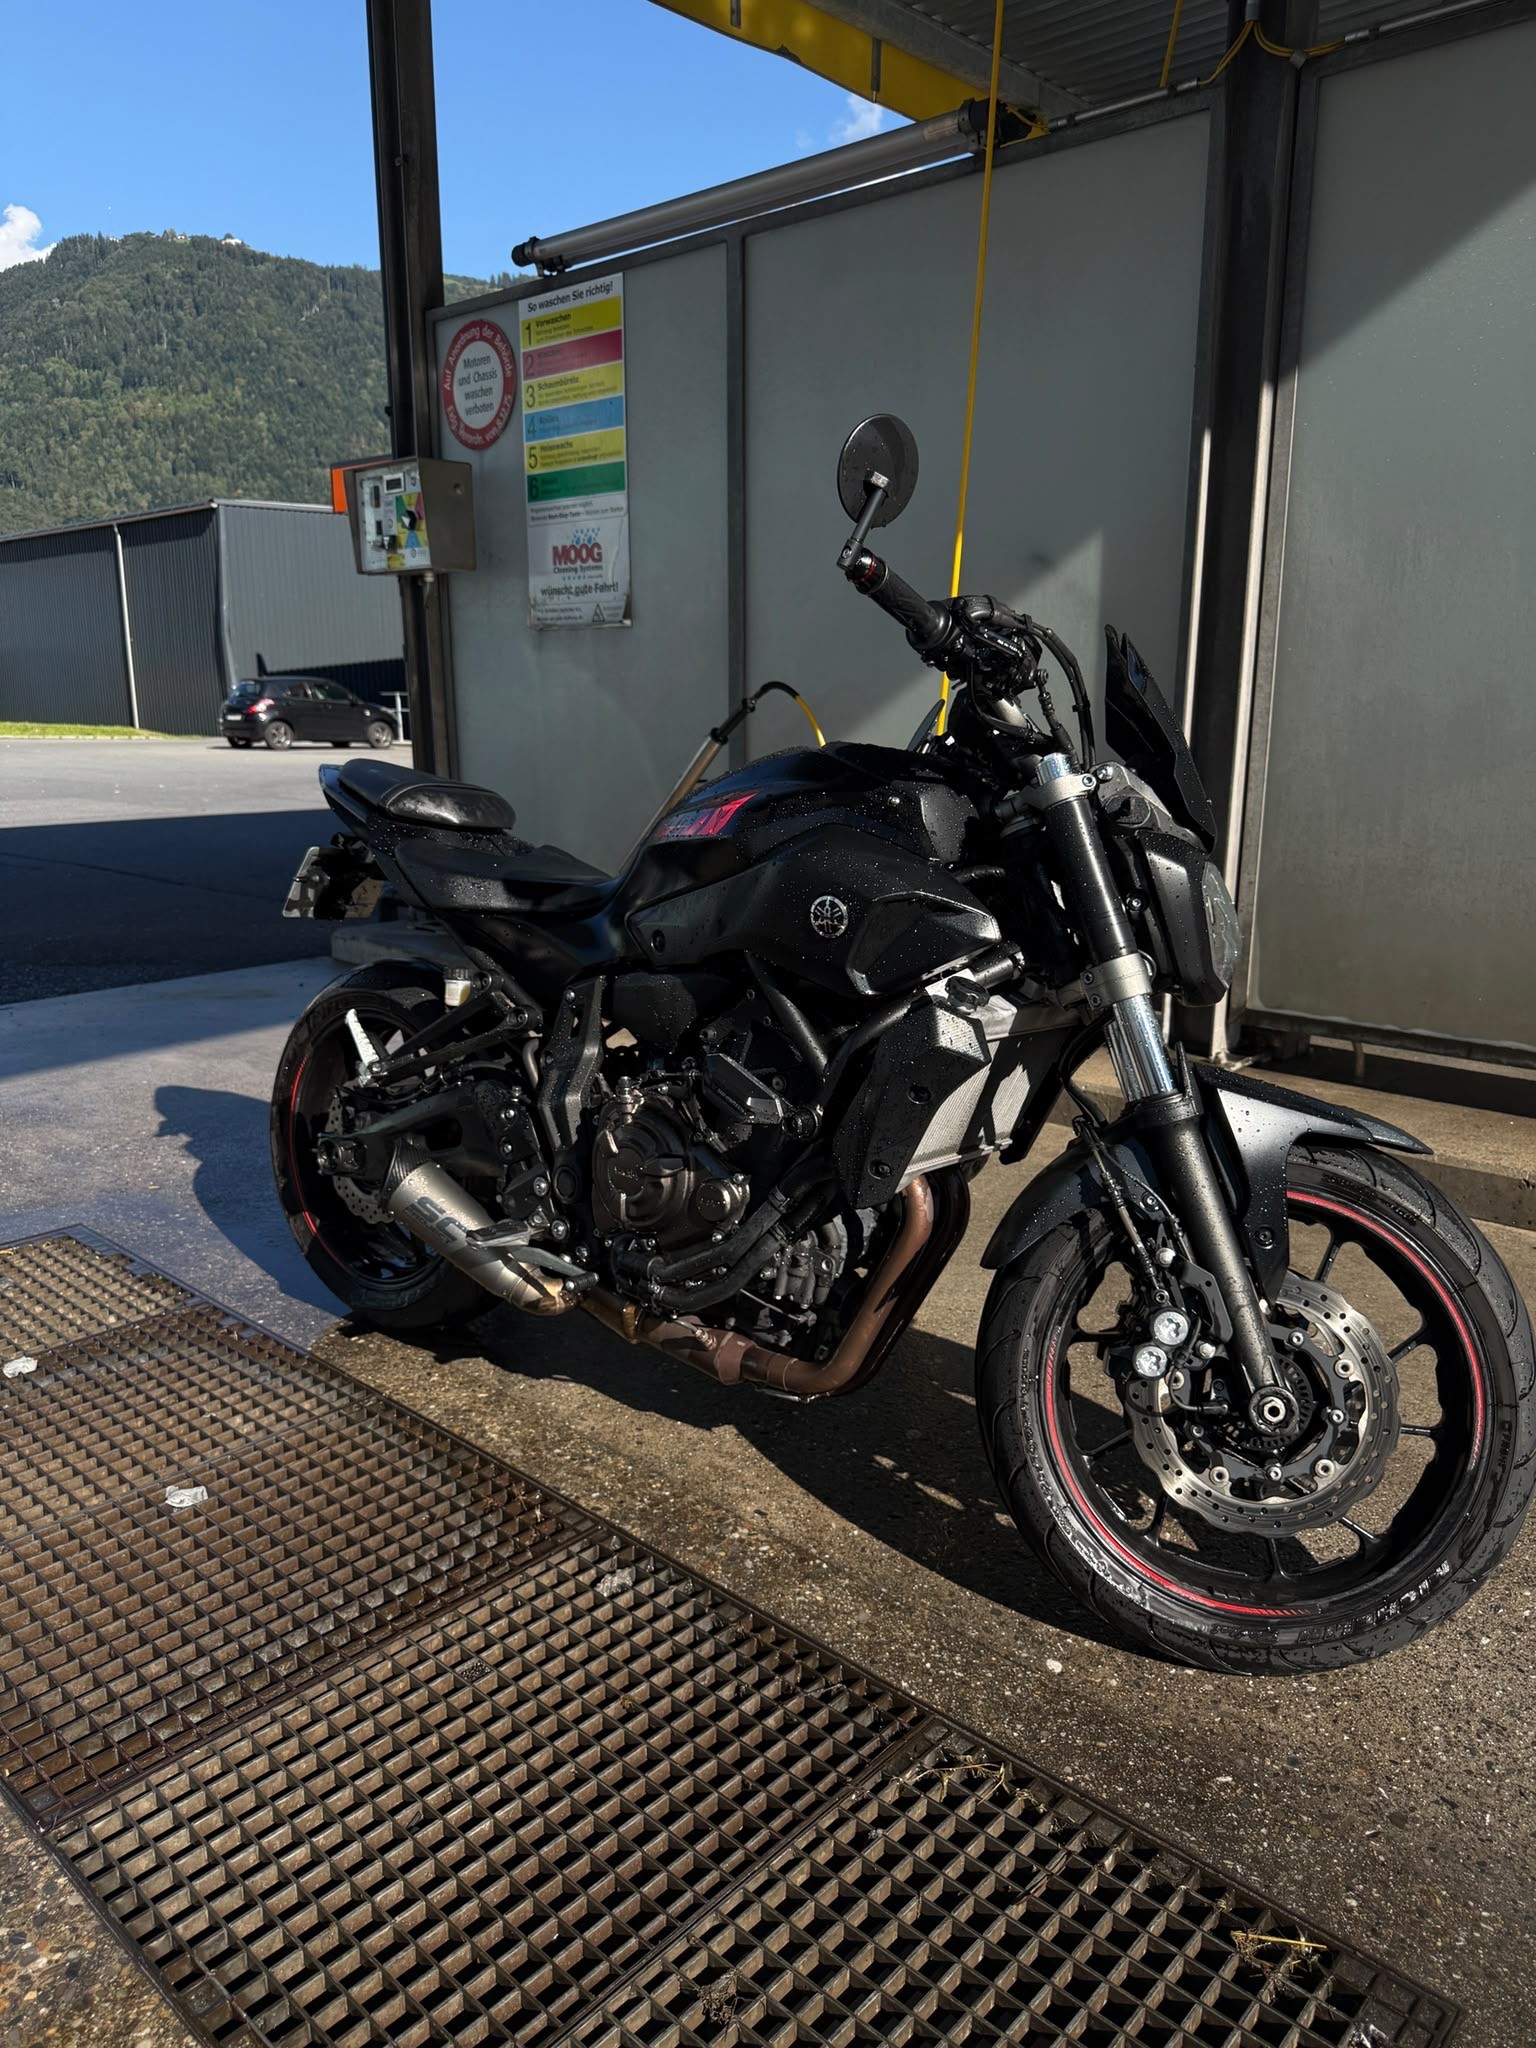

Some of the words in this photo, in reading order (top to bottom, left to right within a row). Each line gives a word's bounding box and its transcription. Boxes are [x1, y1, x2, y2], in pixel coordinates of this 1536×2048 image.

[528, 302, 537, 313] So
[538, 293, 571, 310] waschen
[572, 289, 584, 301] Sie
[585, 281, 613, 297] richtig!
[525, 321, 532, 346] 1
[463, 355, 491, 370] Motoren
[526, 353, 535, 377] 2
[458, 373, 471, 387] und
[472, 367, 498, 384] Chassis
[464, 386, 494, 401] waschen
[526, 384, 536, 409] 3
[464, 402, 495, 417] verboten
[527, 415, 536, 438] 4
[528, 446, 538, 470] 5
[529, 477, 539, 499] 6
[552, 542, 603, 566] MOOG
[540, 584, 573, 597] wünscht
[574, 583, 593, 597] gute
[594, 581, 619, 593] Fahrt!
